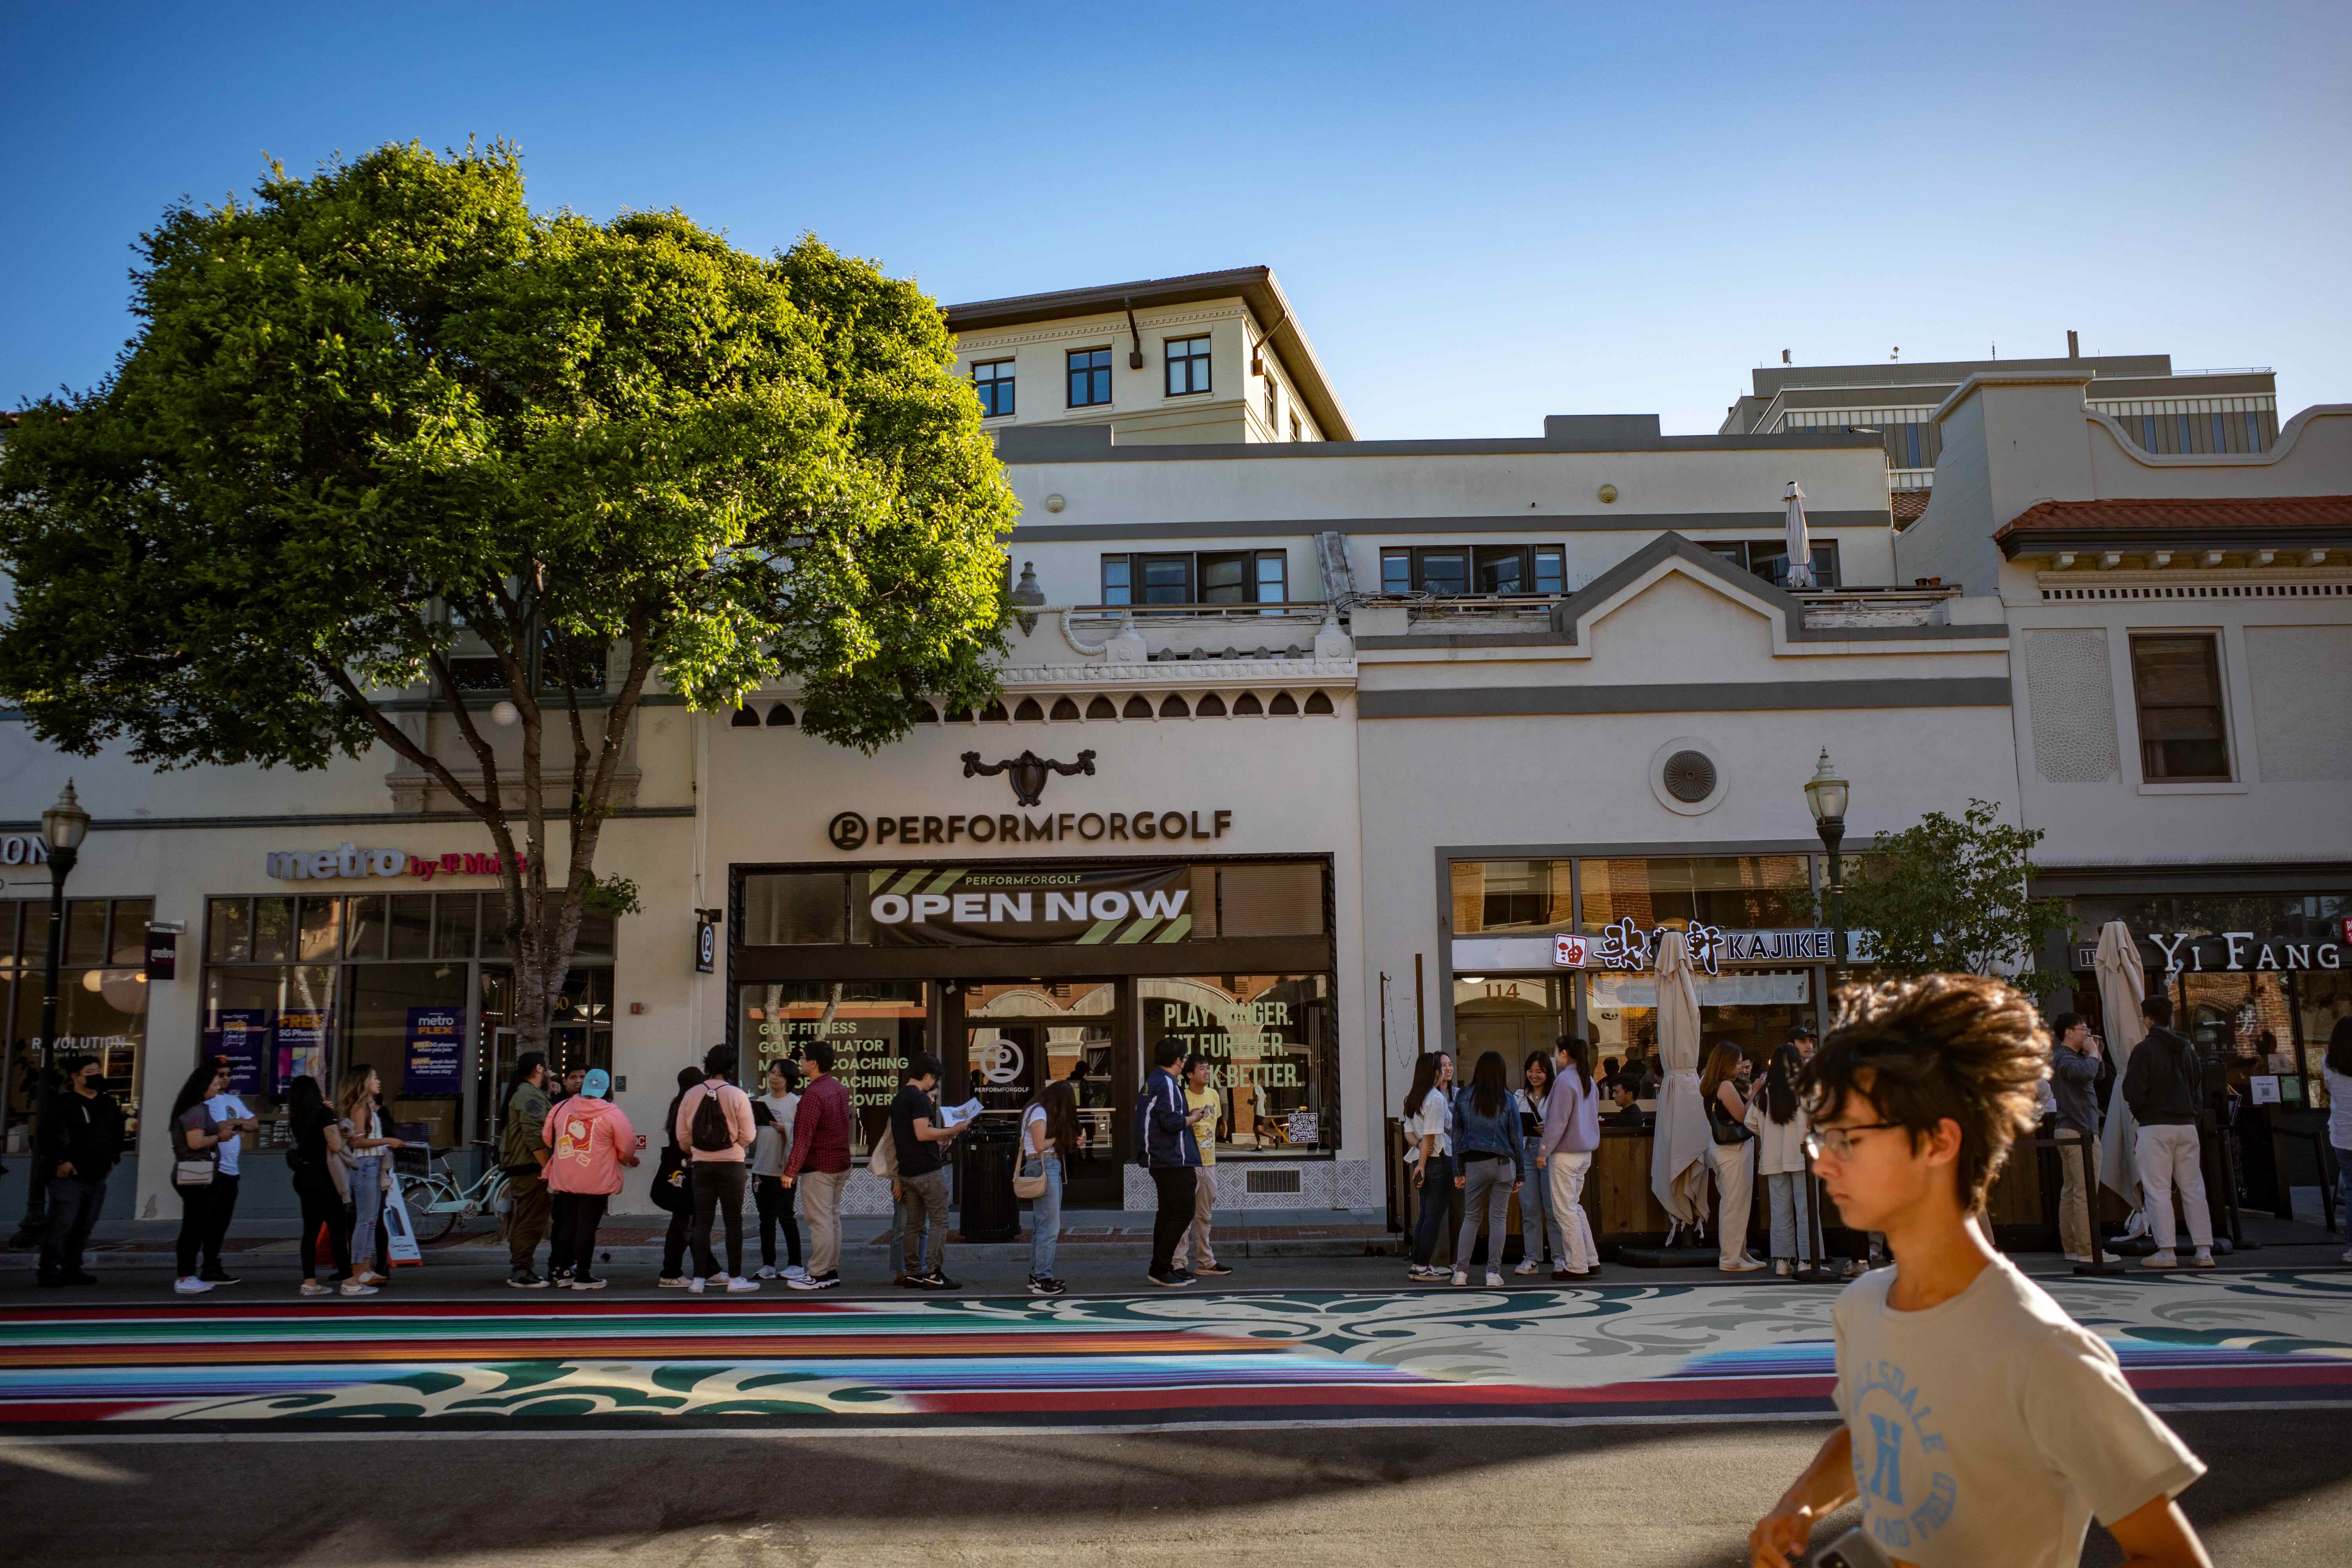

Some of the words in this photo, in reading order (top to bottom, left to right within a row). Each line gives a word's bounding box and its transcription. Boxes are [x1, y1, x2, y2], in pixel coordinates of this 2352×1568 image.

[877, 810, 1232, 844] PERFORMFORGOLF
[267, 843, 406, 879] metro
[410, 856, 439, 882] by
[965, 875, 1082, 886] PERFORMFORGOLF
[870, 891, 1032, 924] OPEN
[1044, 889, 1190, 922] NOW
[1485, 983, 1520, 1001] 114
[279, 1013, 324, 1028] FREE
[418, 1015, 454, 1026] metro
[1164, 1003, 1209, 1027] PLAY
[1216, 1002, 1294, 1026] LONGER.
[278, 1028, 291, 1037] 5G
[417, 1026, 452, 1035] FLEX
[759, 1023, 797, 1035] GOLF
[799, 1022, 857, 1035] FITNESS
[32, 1037, 126, 1049] RVOLUTION
[759, 1041, 797, 1053] GOLF
[1227, 1063, 1302, 1088] BETTER.
